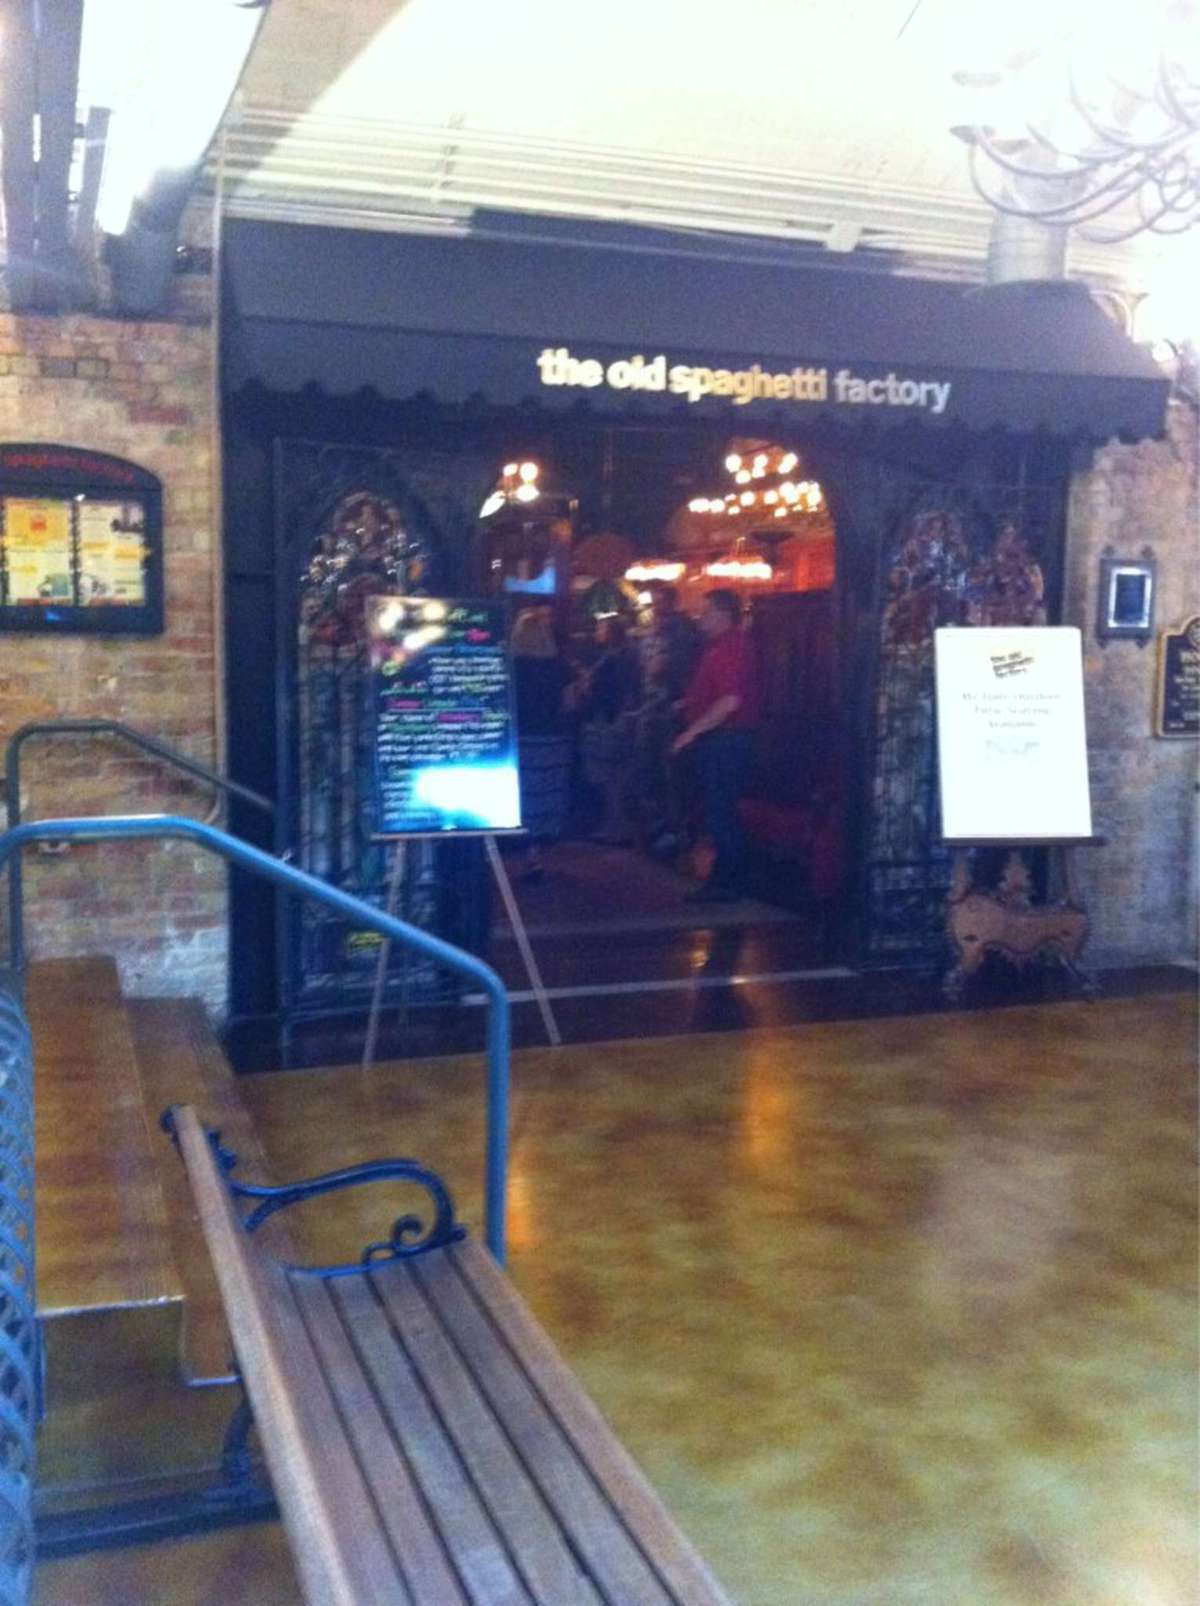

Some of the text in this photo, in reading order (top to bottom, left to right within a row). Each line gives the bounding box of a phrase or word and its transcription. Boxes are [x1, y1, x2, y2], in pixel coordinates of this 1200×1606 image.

[537, 348, 951, 413] the old spaghetti factory
